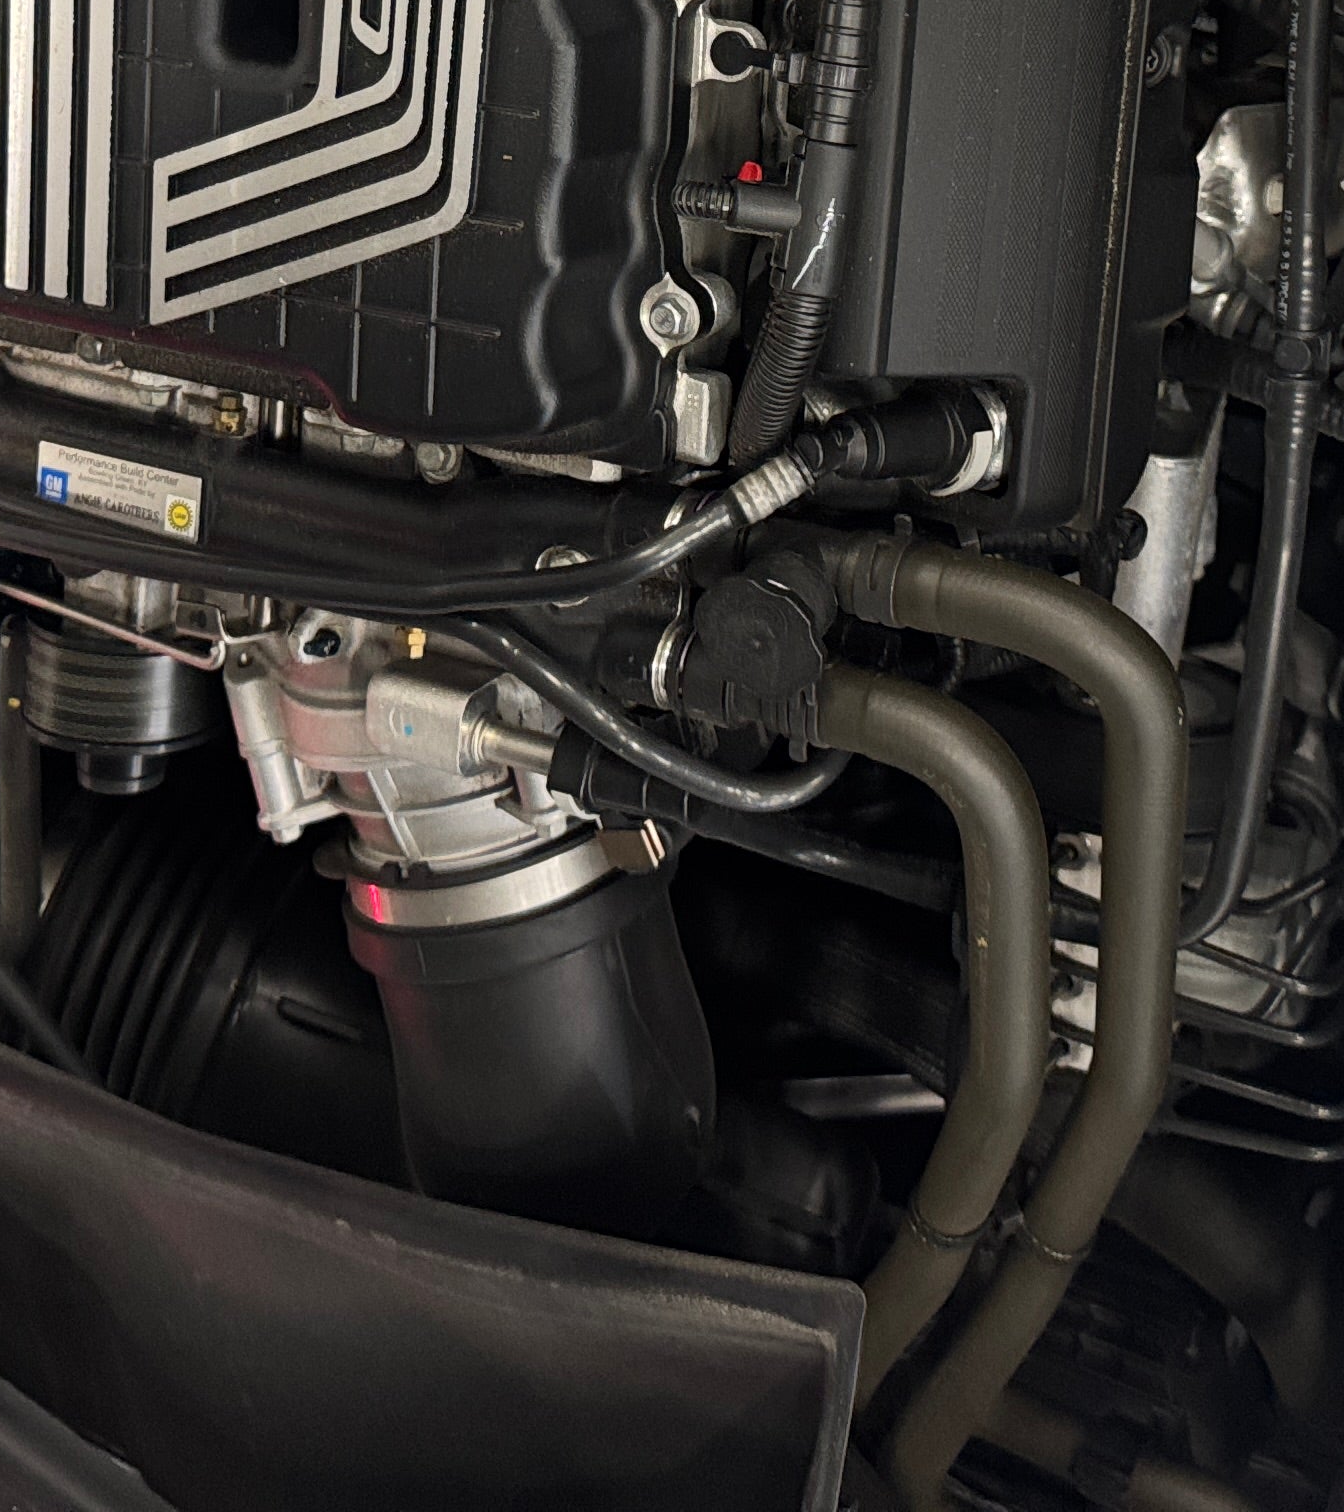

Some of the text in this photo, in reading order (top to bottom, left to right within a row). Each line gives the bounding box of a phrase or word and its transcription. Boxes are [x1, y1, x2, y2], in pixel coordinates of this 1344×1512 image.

[58, 448, 179, 486] Performance Build Center
[45, 474, 63, 493] GM
